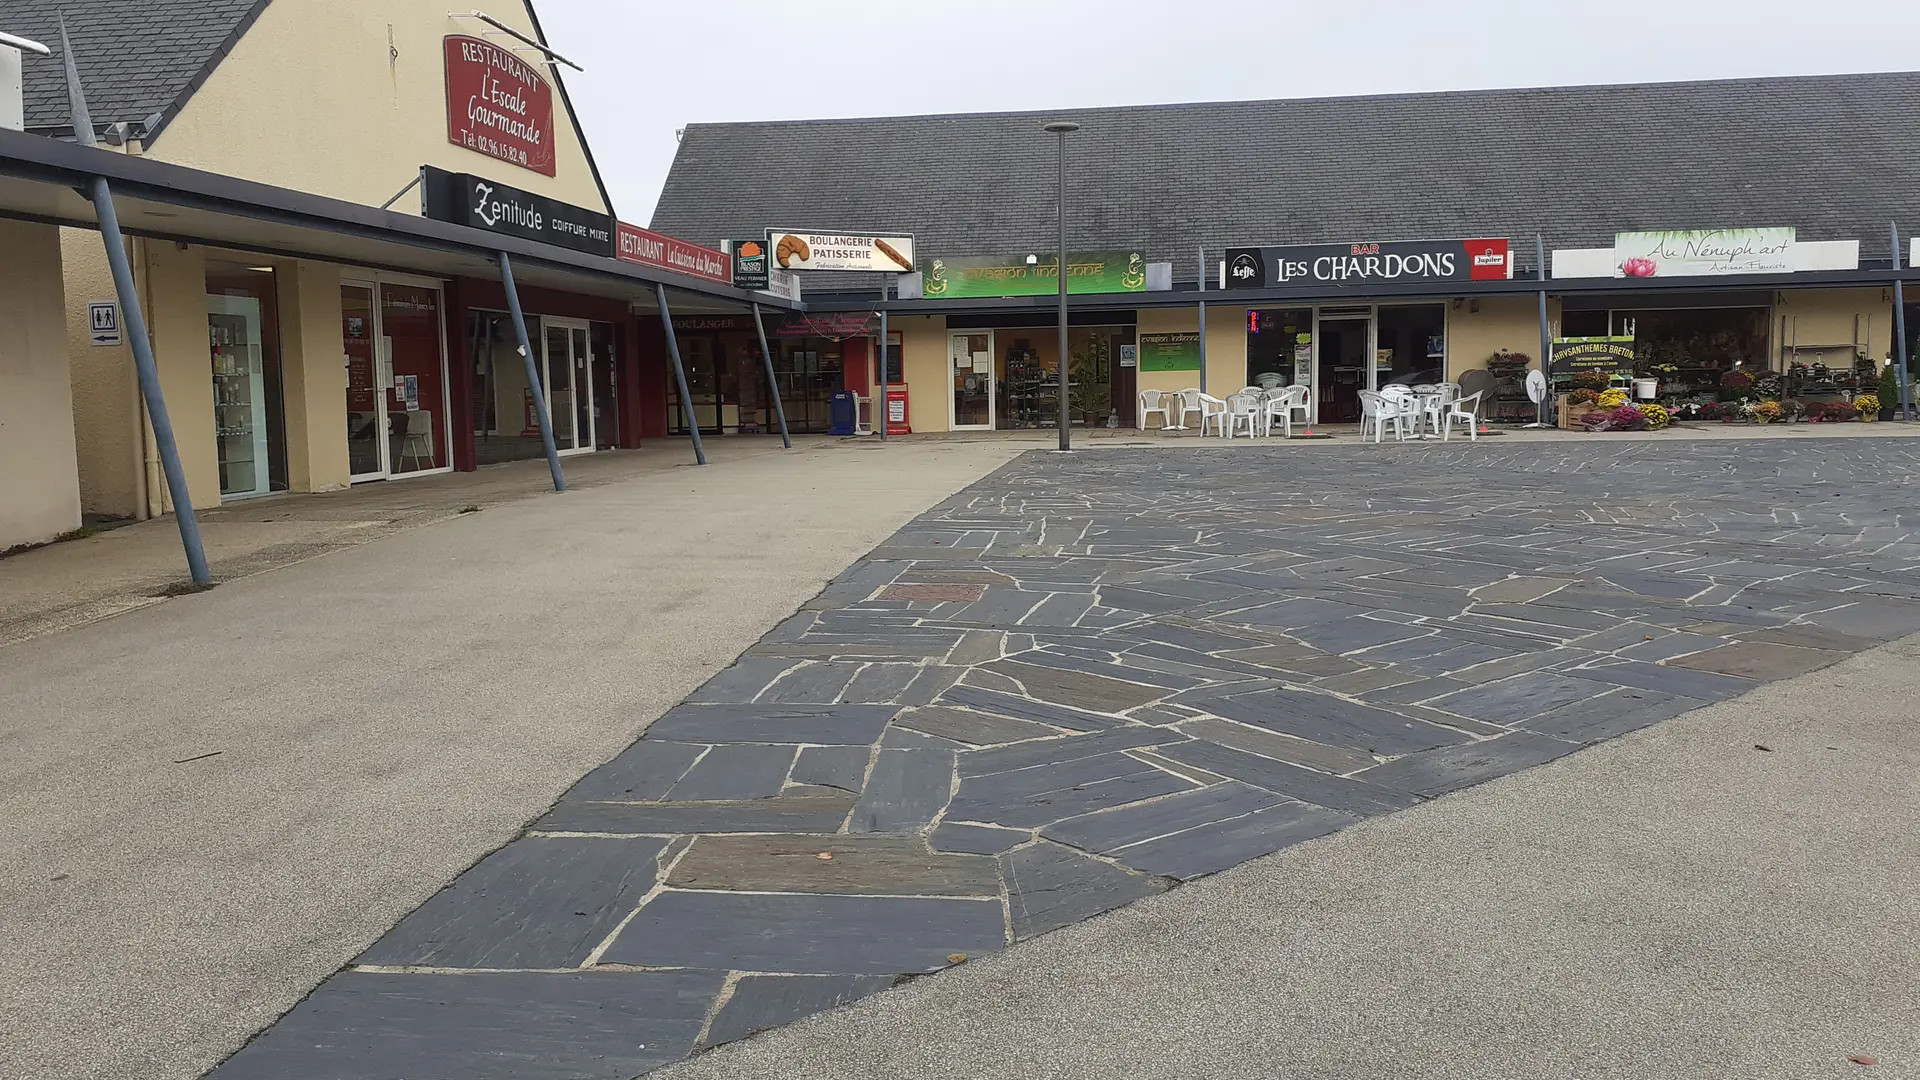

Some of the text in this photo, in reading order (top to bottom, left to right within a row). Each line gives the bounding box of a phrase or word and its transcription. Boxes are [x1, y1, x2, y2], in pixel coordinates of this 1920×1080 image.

[461, 42, 540, 92] RESTAURANT
[481, 68, 527, 116] L'Escale
[467, 95, 540, 145] Gourmande
[477, 136, 528, 166] 02.96.15.82.40
[473, 182, 609, 242] Zenitude COIFFURE MIXTE
[620, 231, 664, 262] RESTAURANT
[809, 236, 872, 247] BOULANGERIE
[813, 249, 872, 259] PATISSERIE
[1351, 244, 1380, 256] BAR
[1647, 230, 1790, 263] Au Nénuph'art
[1232, 266, 1255, 280] Leffe
[1313, 252, 1456, 280] CHARDONS
[1476, 255, 1502, 265] Jupiler
[1709, 259, 1787, 272] Artisan Fleuriste
